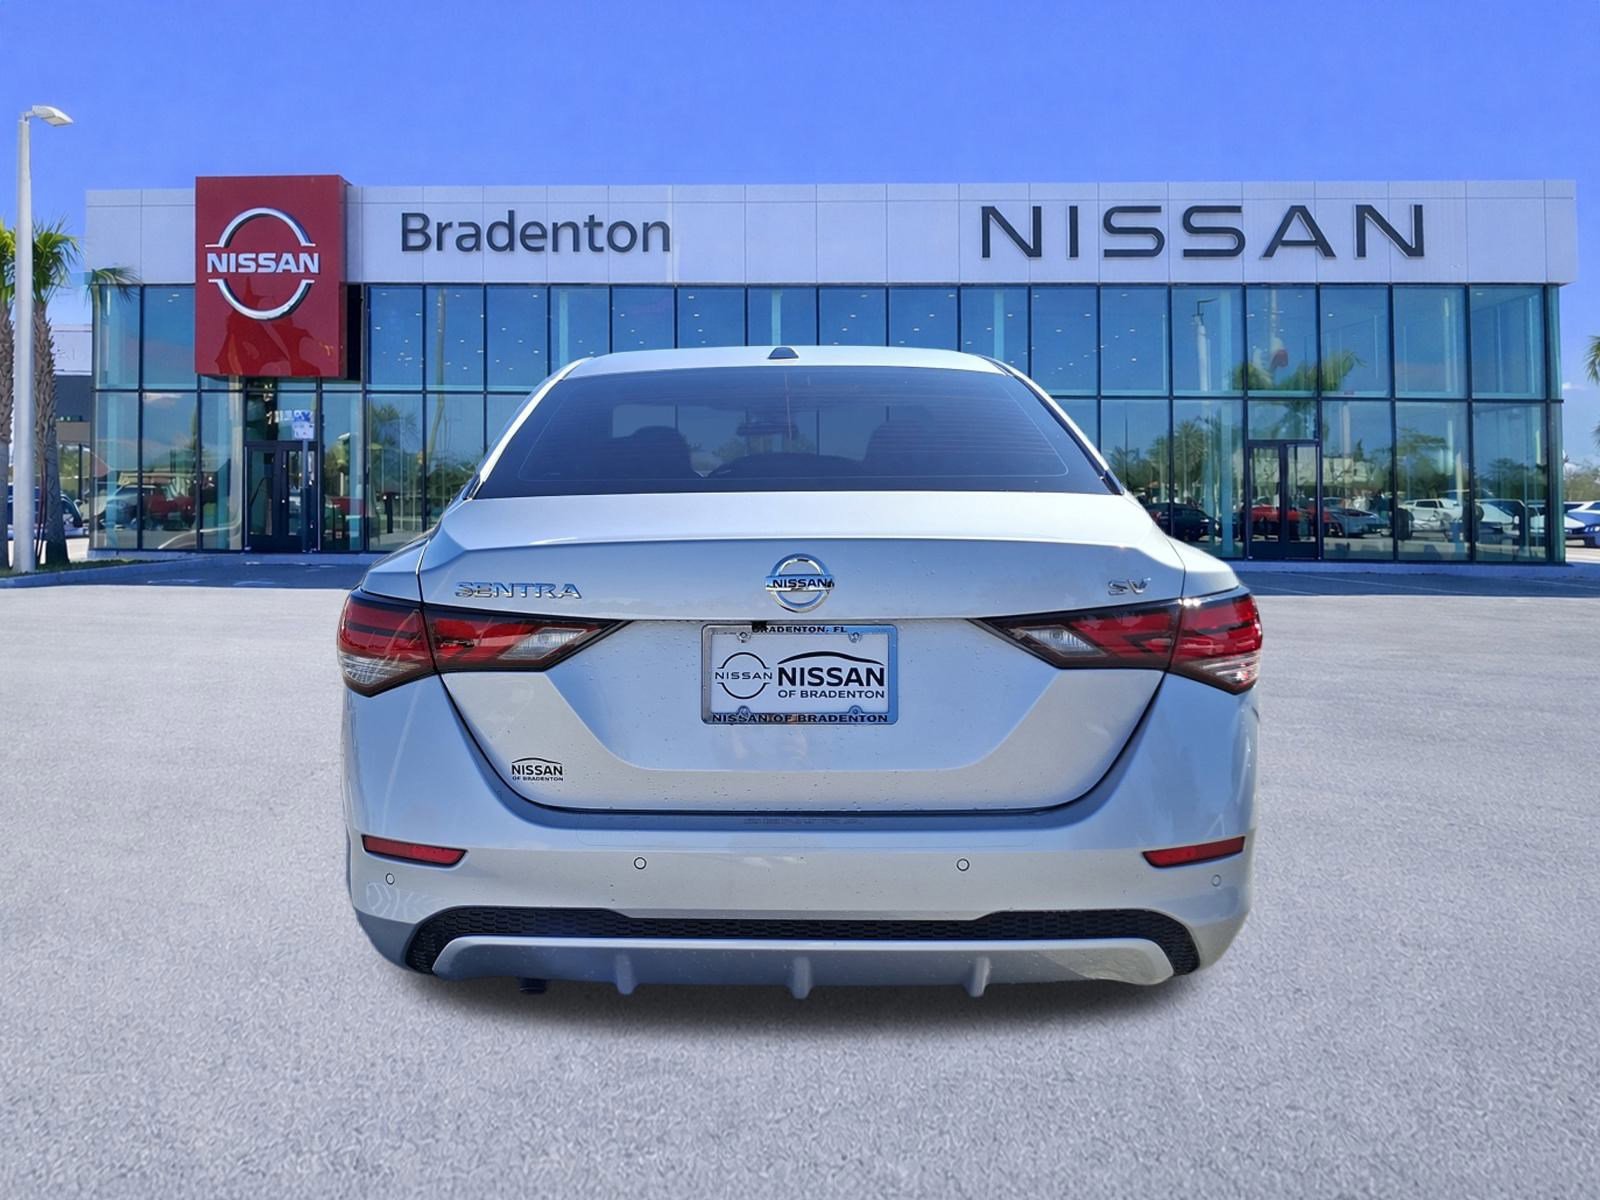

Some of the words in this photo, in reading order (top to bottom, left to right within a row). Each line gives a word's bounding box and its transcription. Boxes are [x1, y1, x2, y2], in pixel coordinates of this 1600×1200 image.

[401, 209, 671, 253] Bradenton
[980, 204, 1425, 259] NISSAN
[206, 252, 320, 274] NISSAN
[455, 581, 582, 600] SENTRA
[772, 578, 828, 588] NISSAN
[1108, 577, 1151, 596] SV
[714, 671, 773, 680] NISSAN
[778, 667, 885, 687] NISSAN
[778, 689, 797, 698] OF
[800, 690, 885, 699] BRADENTON
[712, 714, 768, 723] NISSAN
[773, 714, 793, 723] OF
[797, 714, 888, 723] BRADENTON
[511, 764, 563, 776] NISSAN
